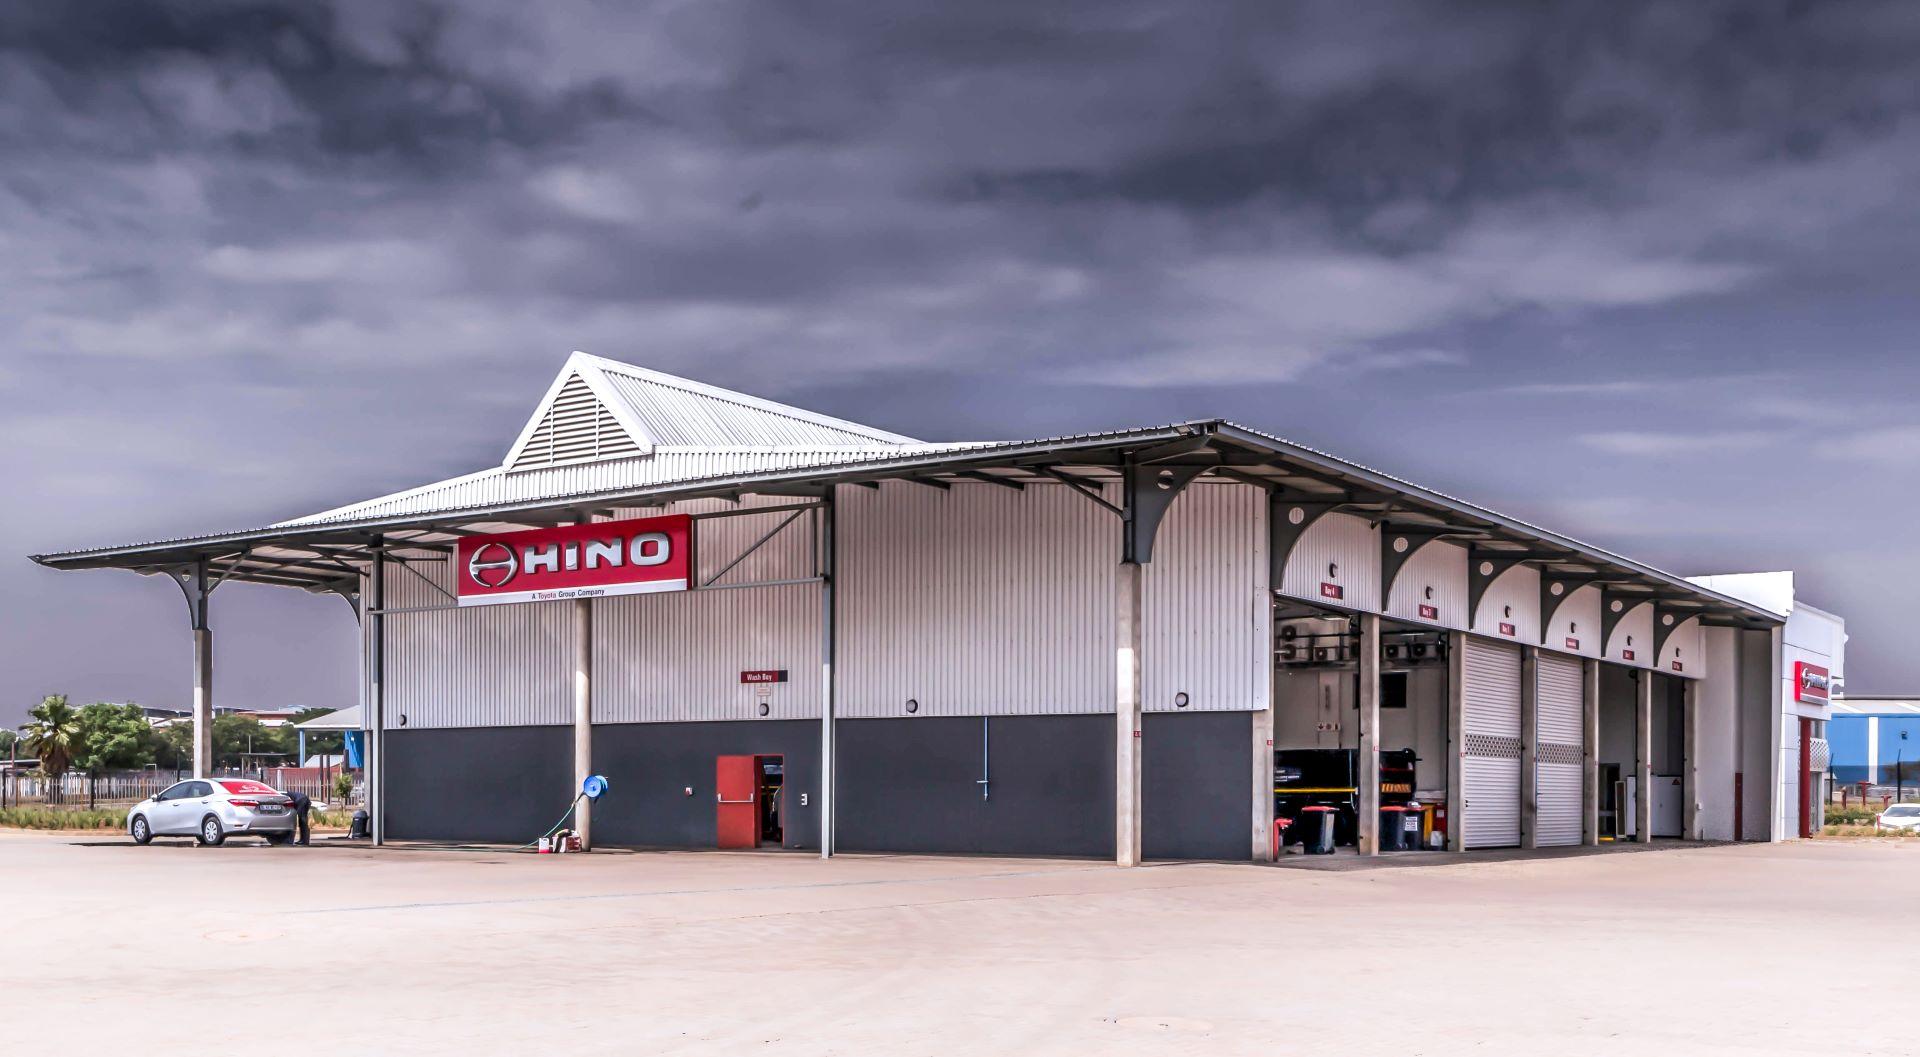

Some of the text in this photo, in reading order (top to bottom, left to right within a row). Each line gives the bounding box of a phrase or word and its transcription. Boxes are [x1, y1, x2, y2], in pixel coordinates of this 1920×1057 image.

[524, 532, 670, 574] HINO
[538, 592, 557, 600] Toyota
[558, 590, 576, 598] Group
[577, 589, 605, 597] Company
[746, 673, 772, 682] Wash Bay
